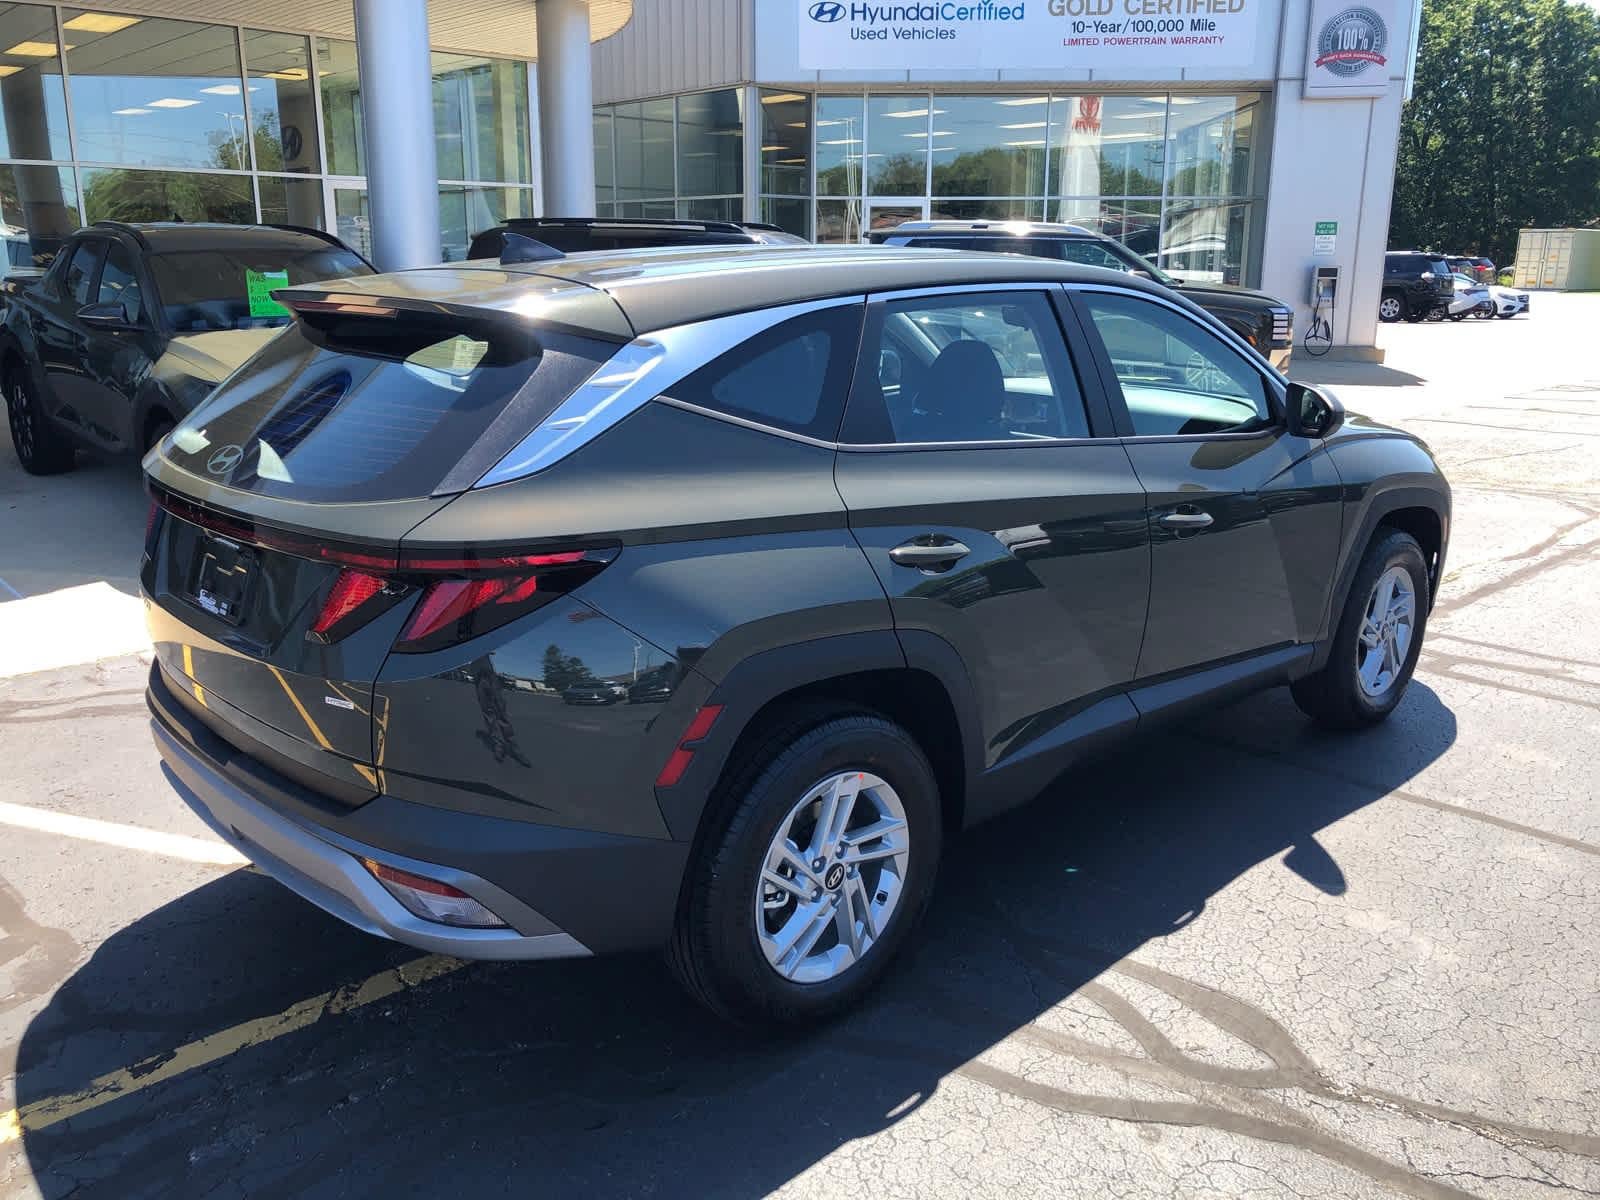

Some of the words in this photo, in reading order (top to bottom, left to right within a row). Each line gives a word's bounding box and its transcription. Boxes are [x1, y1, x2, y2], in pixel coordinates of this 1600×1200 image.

[1048, 0, 1113, 17] GOLD
[1124, 0, 1245, 15] CERTIFIED
[850, 27, 888, 41] Used
[893, 26, 957, 41] Vehicles
[1071, 18, 1185, 34] 10-Year/100,000
[1190, 18, 1217, 32] Mile
[1063, 38, 1100, 47] LIMITED
[1103, 37, 1167, 46] POWERTRAIN
[1171, 35, 1225, 45] WARRANTY
[1337, 26, 1369, 51] 100%
